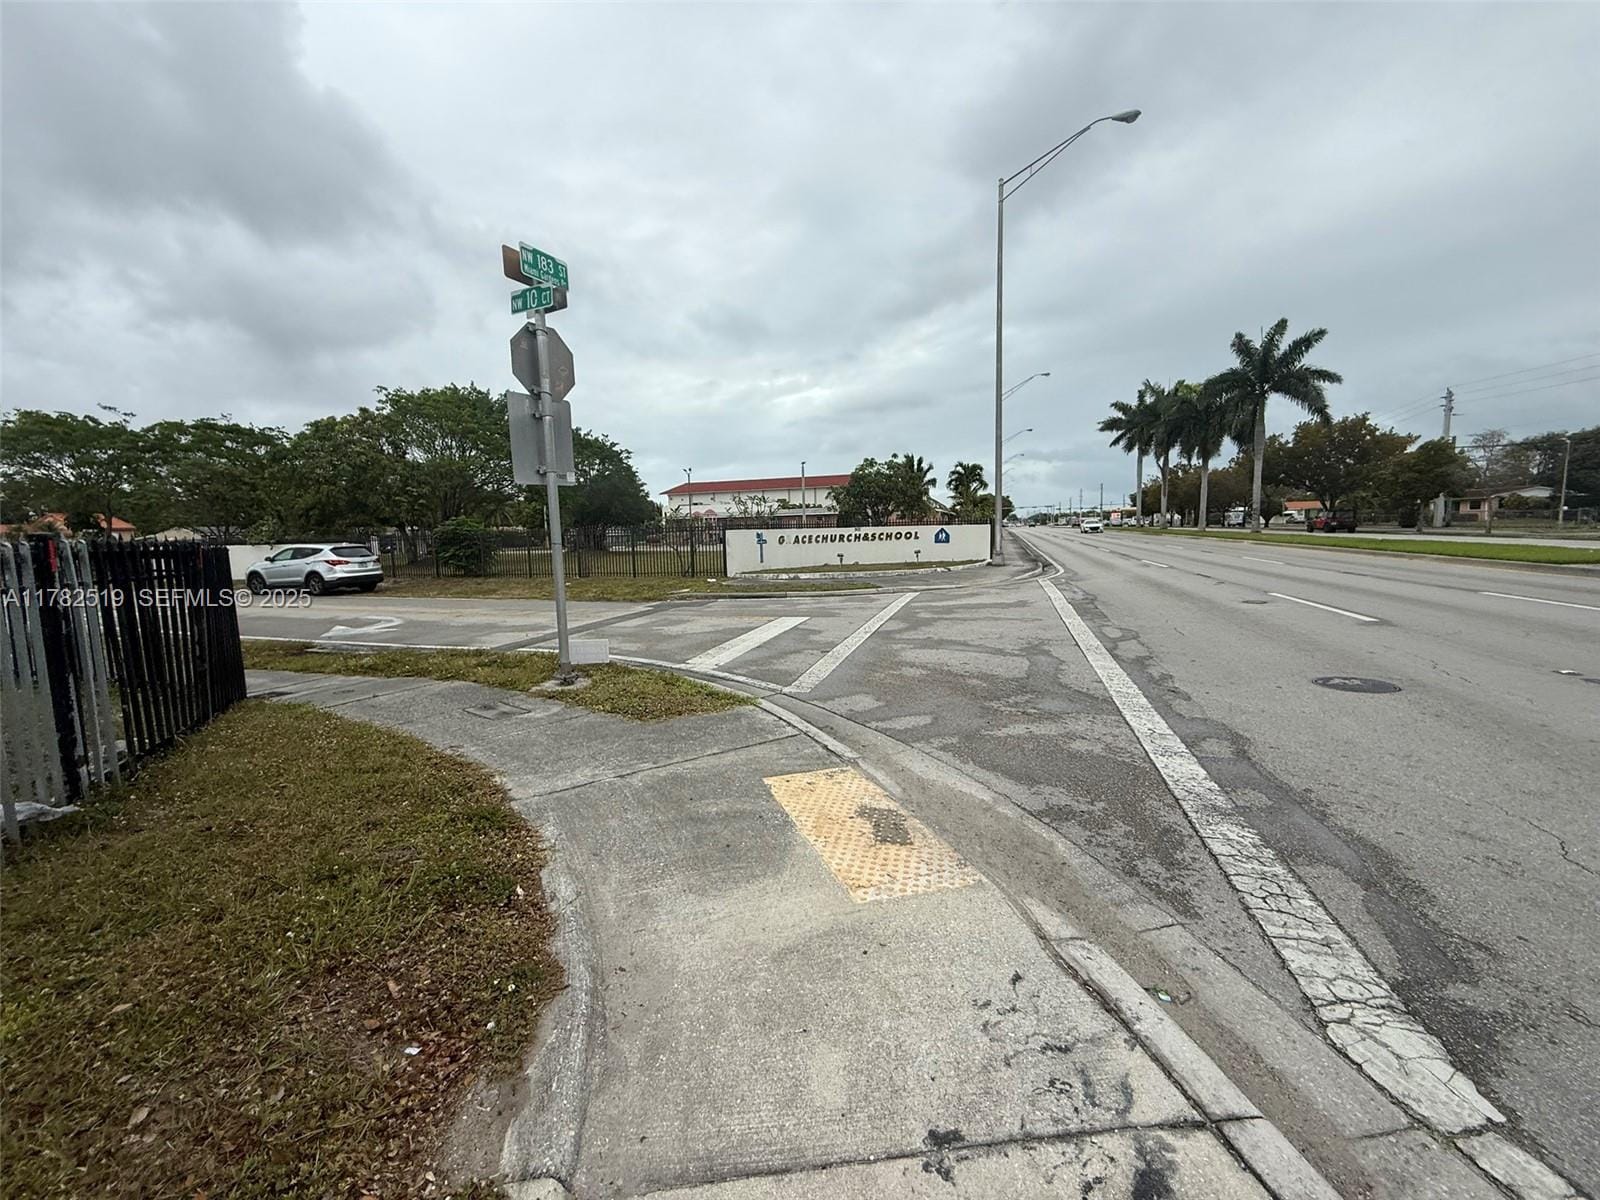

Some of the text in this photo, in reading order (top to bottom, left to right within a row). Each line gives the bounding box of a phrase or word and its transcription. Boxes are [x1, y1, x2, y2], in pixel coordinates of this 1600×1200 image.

[521, 248, 533, 264] NW
[537, 254, 554, 274] 183
[558, 265, 566, 279] ST
[512, 298, 523, 311] NW
[541, 291, 550, 304] CT
